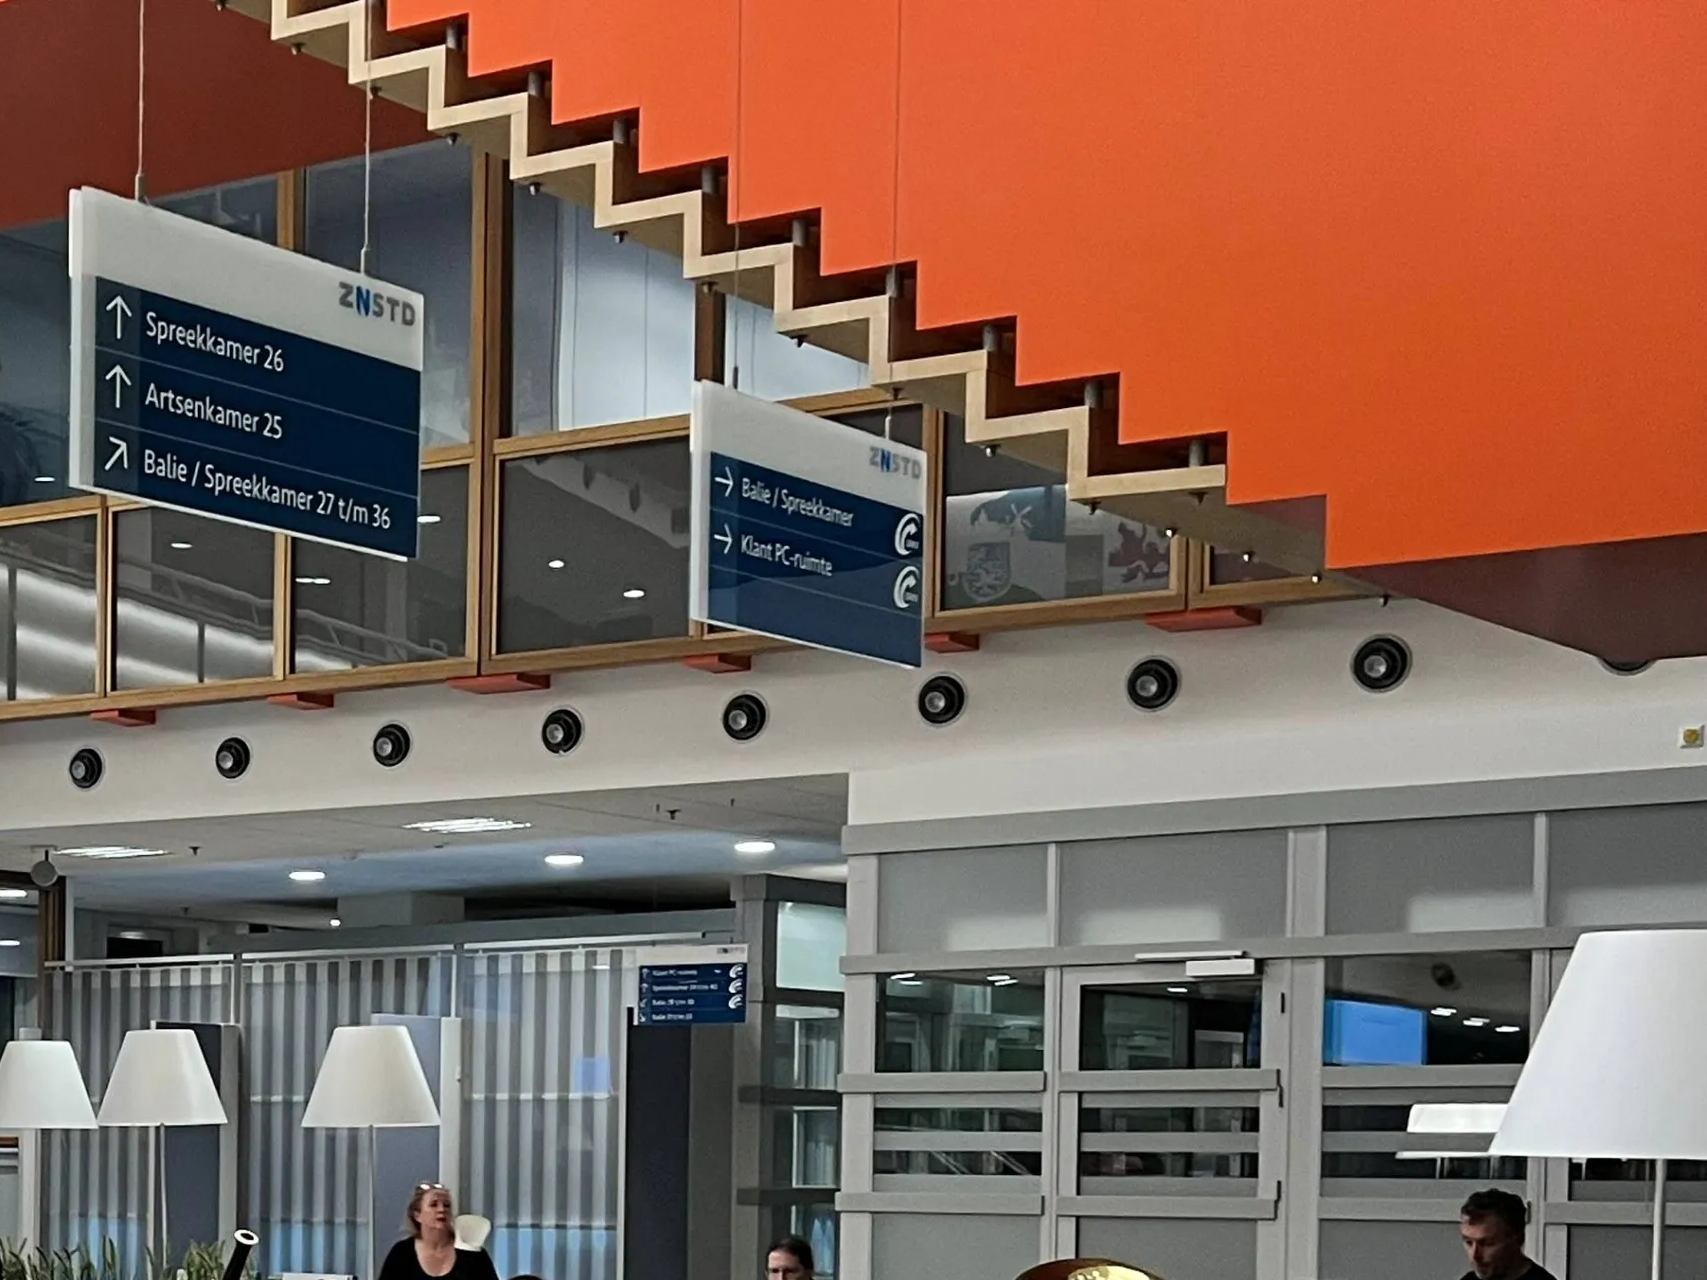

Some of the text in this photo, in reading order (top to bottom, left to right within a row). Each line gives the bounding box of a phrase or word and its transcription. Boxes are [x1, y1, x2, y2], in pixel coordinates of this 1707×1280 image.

[338, 282, 415, 326] ZNSTD
[146, 312, 284, 372] Spreekkamer 26
[145, 383, 282, 439] Artsenkamer 25
[869, 446, 922, 479] ZNSTD
[144, 449, 391, 529] Balie / Spreekkamer 27 t/m 36
[741, 477, 854, 527] Balie / Spreekkamer
[741, 534, 833, 577] Klant PC-ruimte
